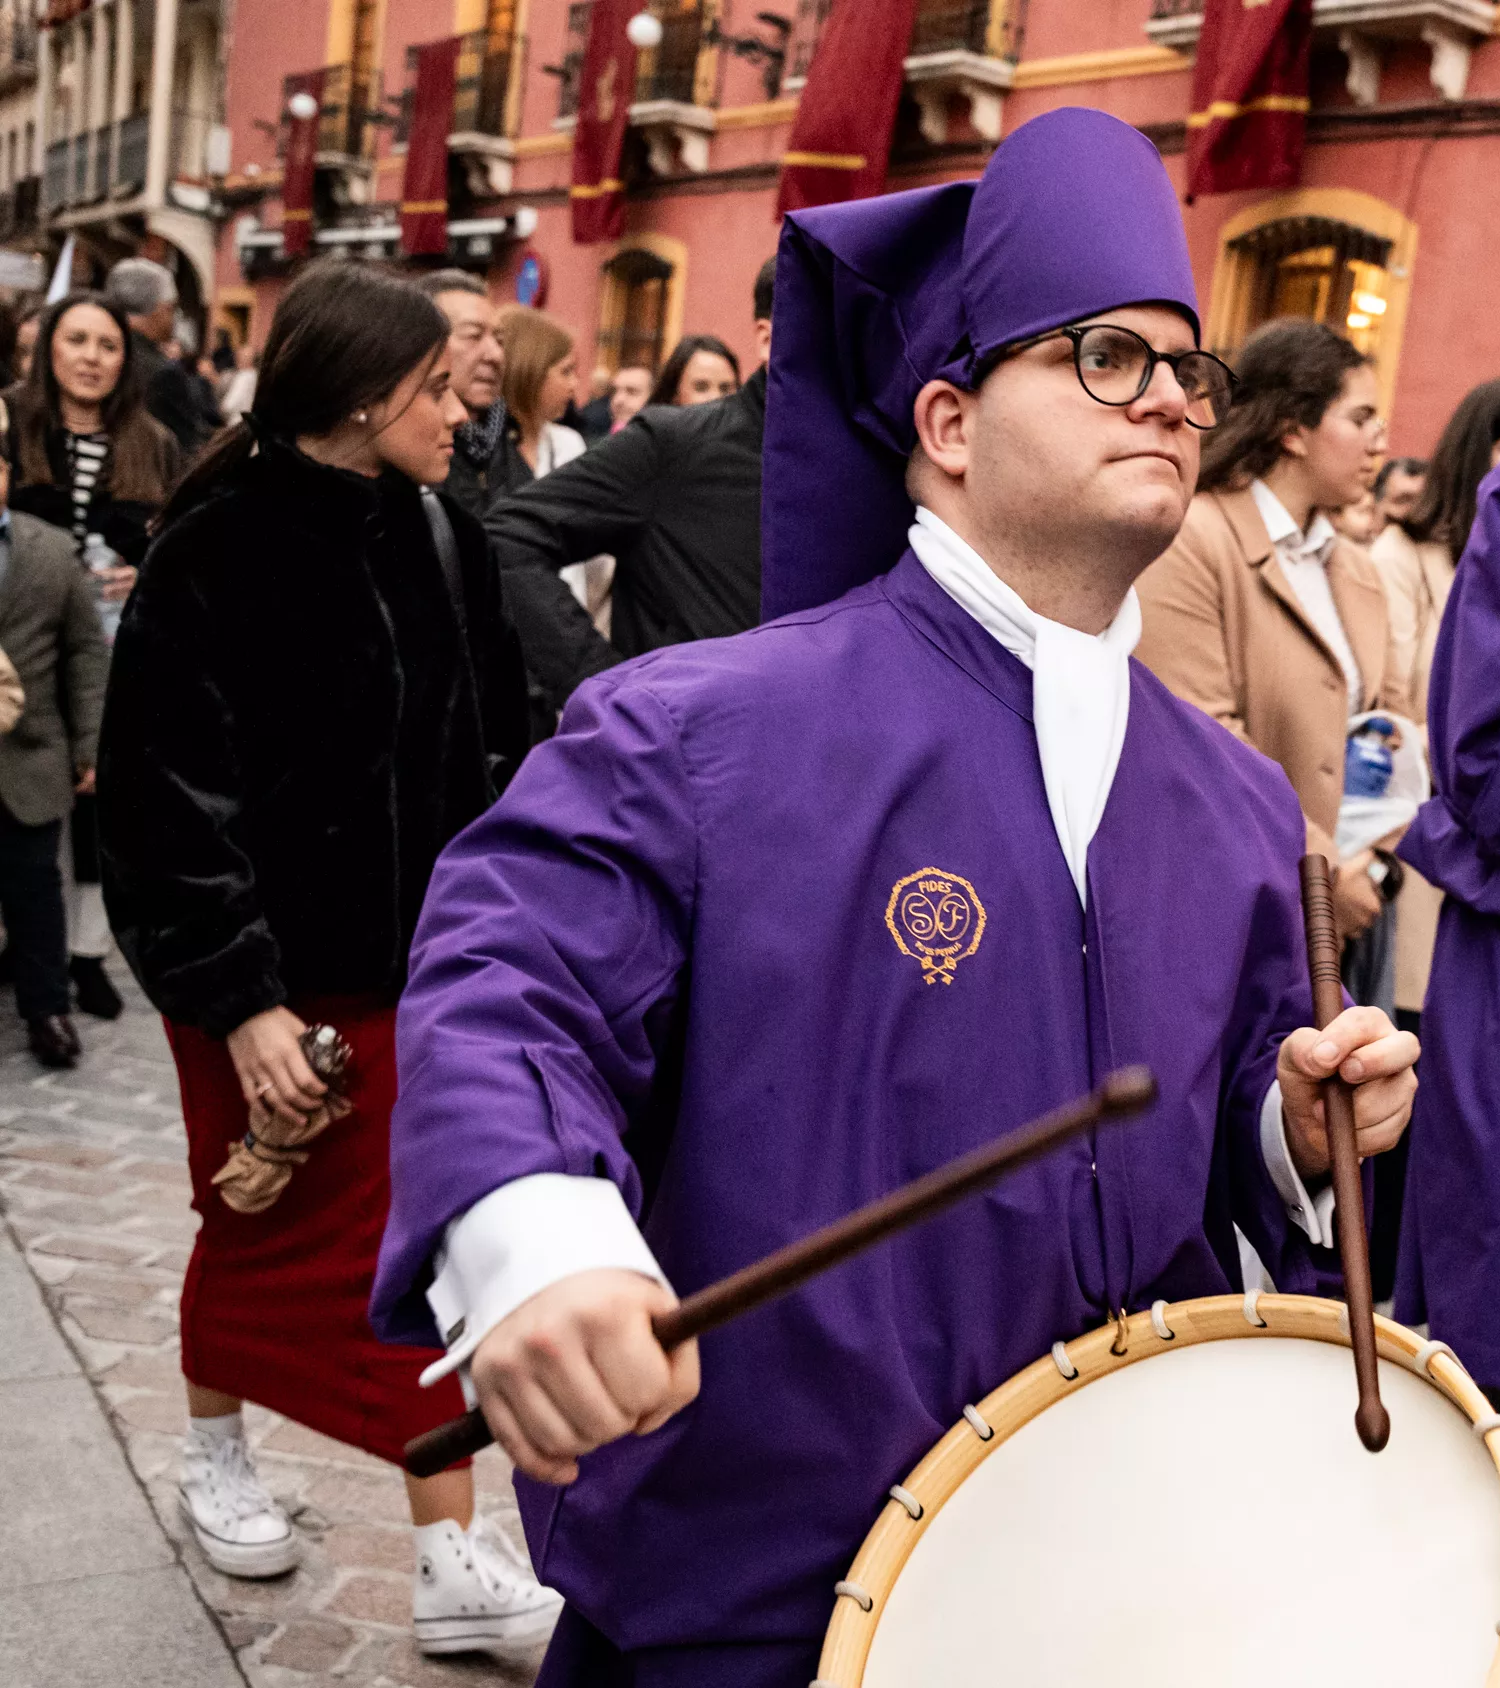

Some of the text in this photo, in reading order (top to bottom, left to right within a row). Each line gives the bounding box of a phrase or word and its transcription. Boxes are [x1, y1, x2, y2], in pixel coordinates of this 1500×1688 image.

[918, 880, 953, 894] FIDES
[908, 901, 966, 934] S F
